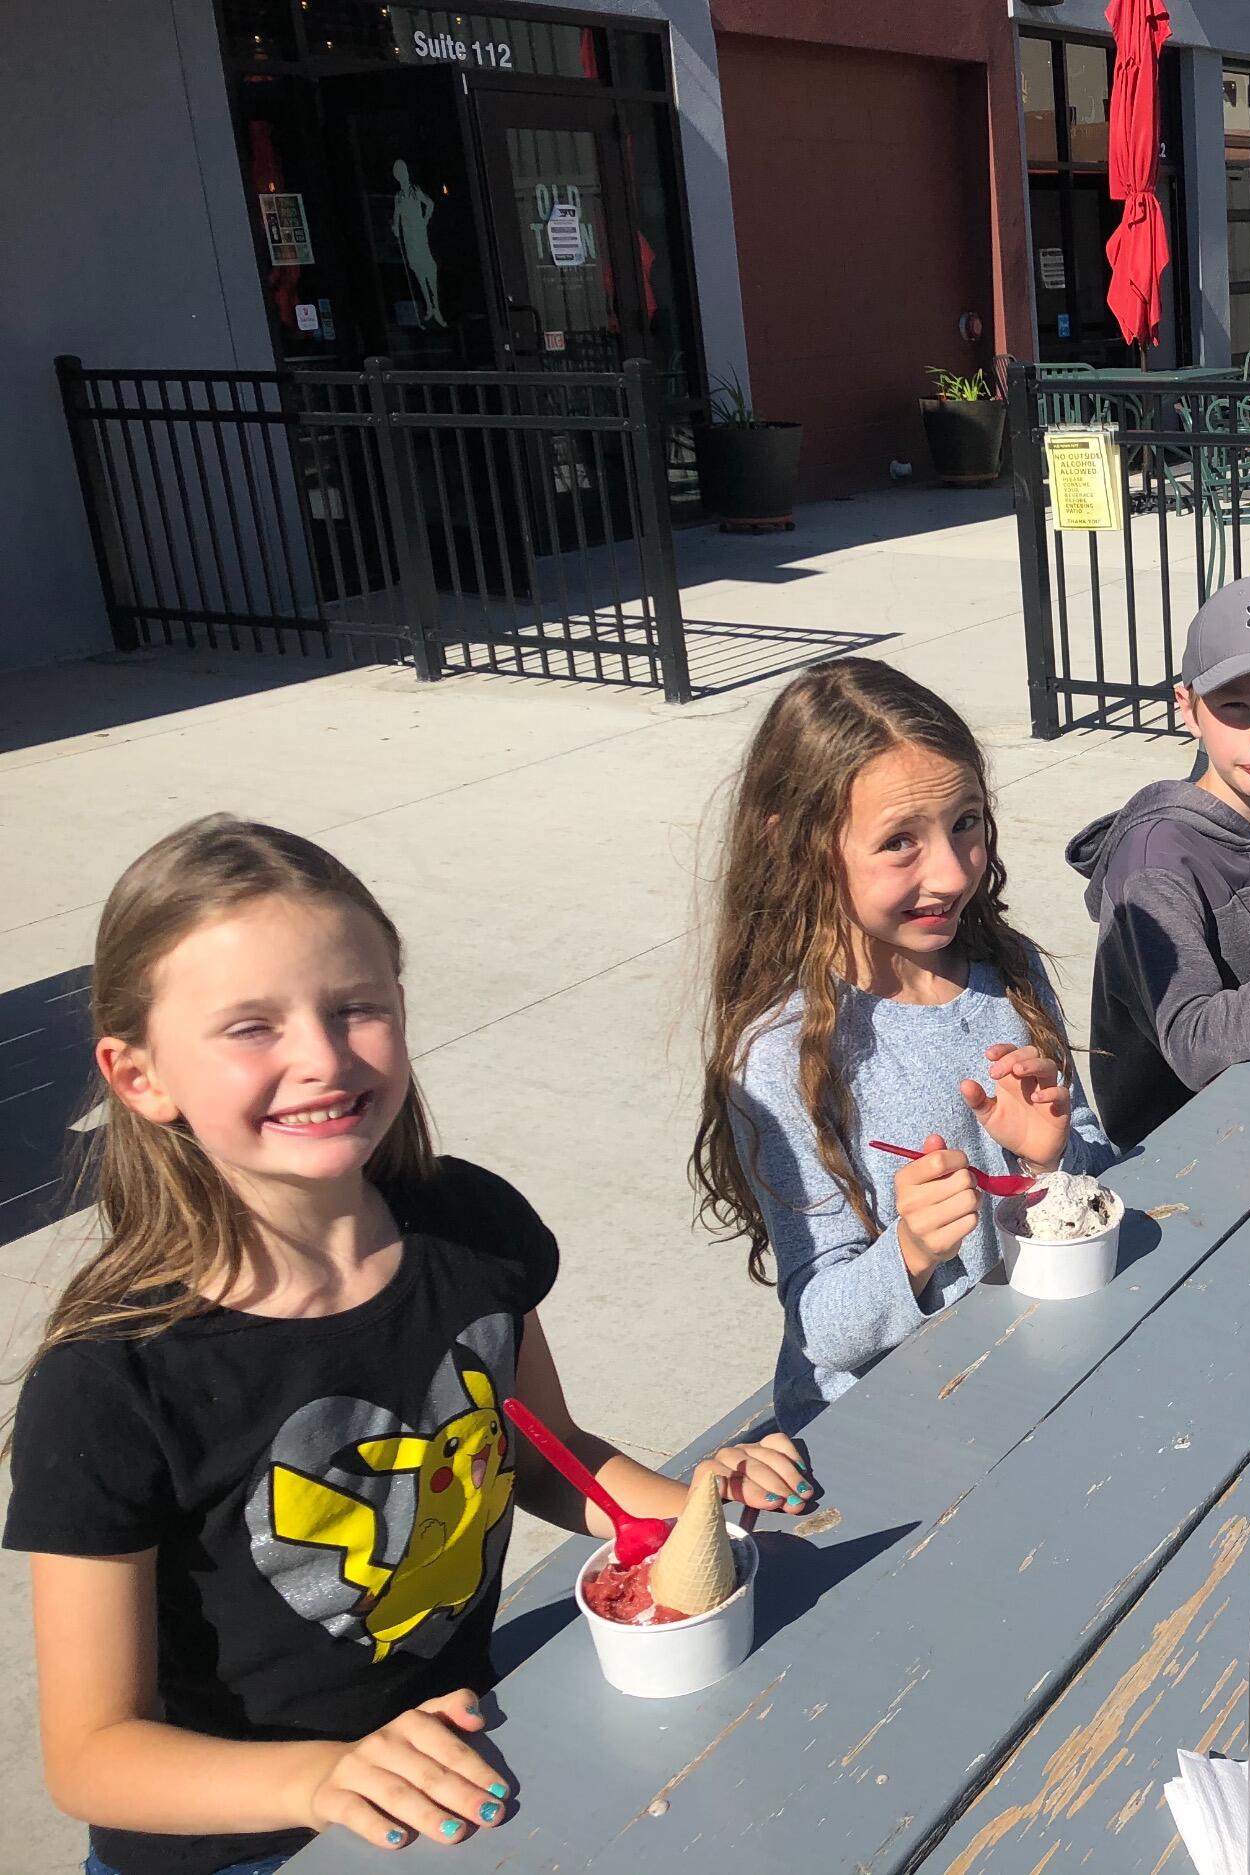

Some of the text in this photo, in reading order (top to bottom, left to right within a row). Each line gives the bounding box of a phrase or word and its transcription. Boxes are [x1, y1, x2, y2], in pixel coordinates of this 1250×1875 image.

[414, 30, 512, 68] Suite 112
[529, 222, 597, 260] TN
